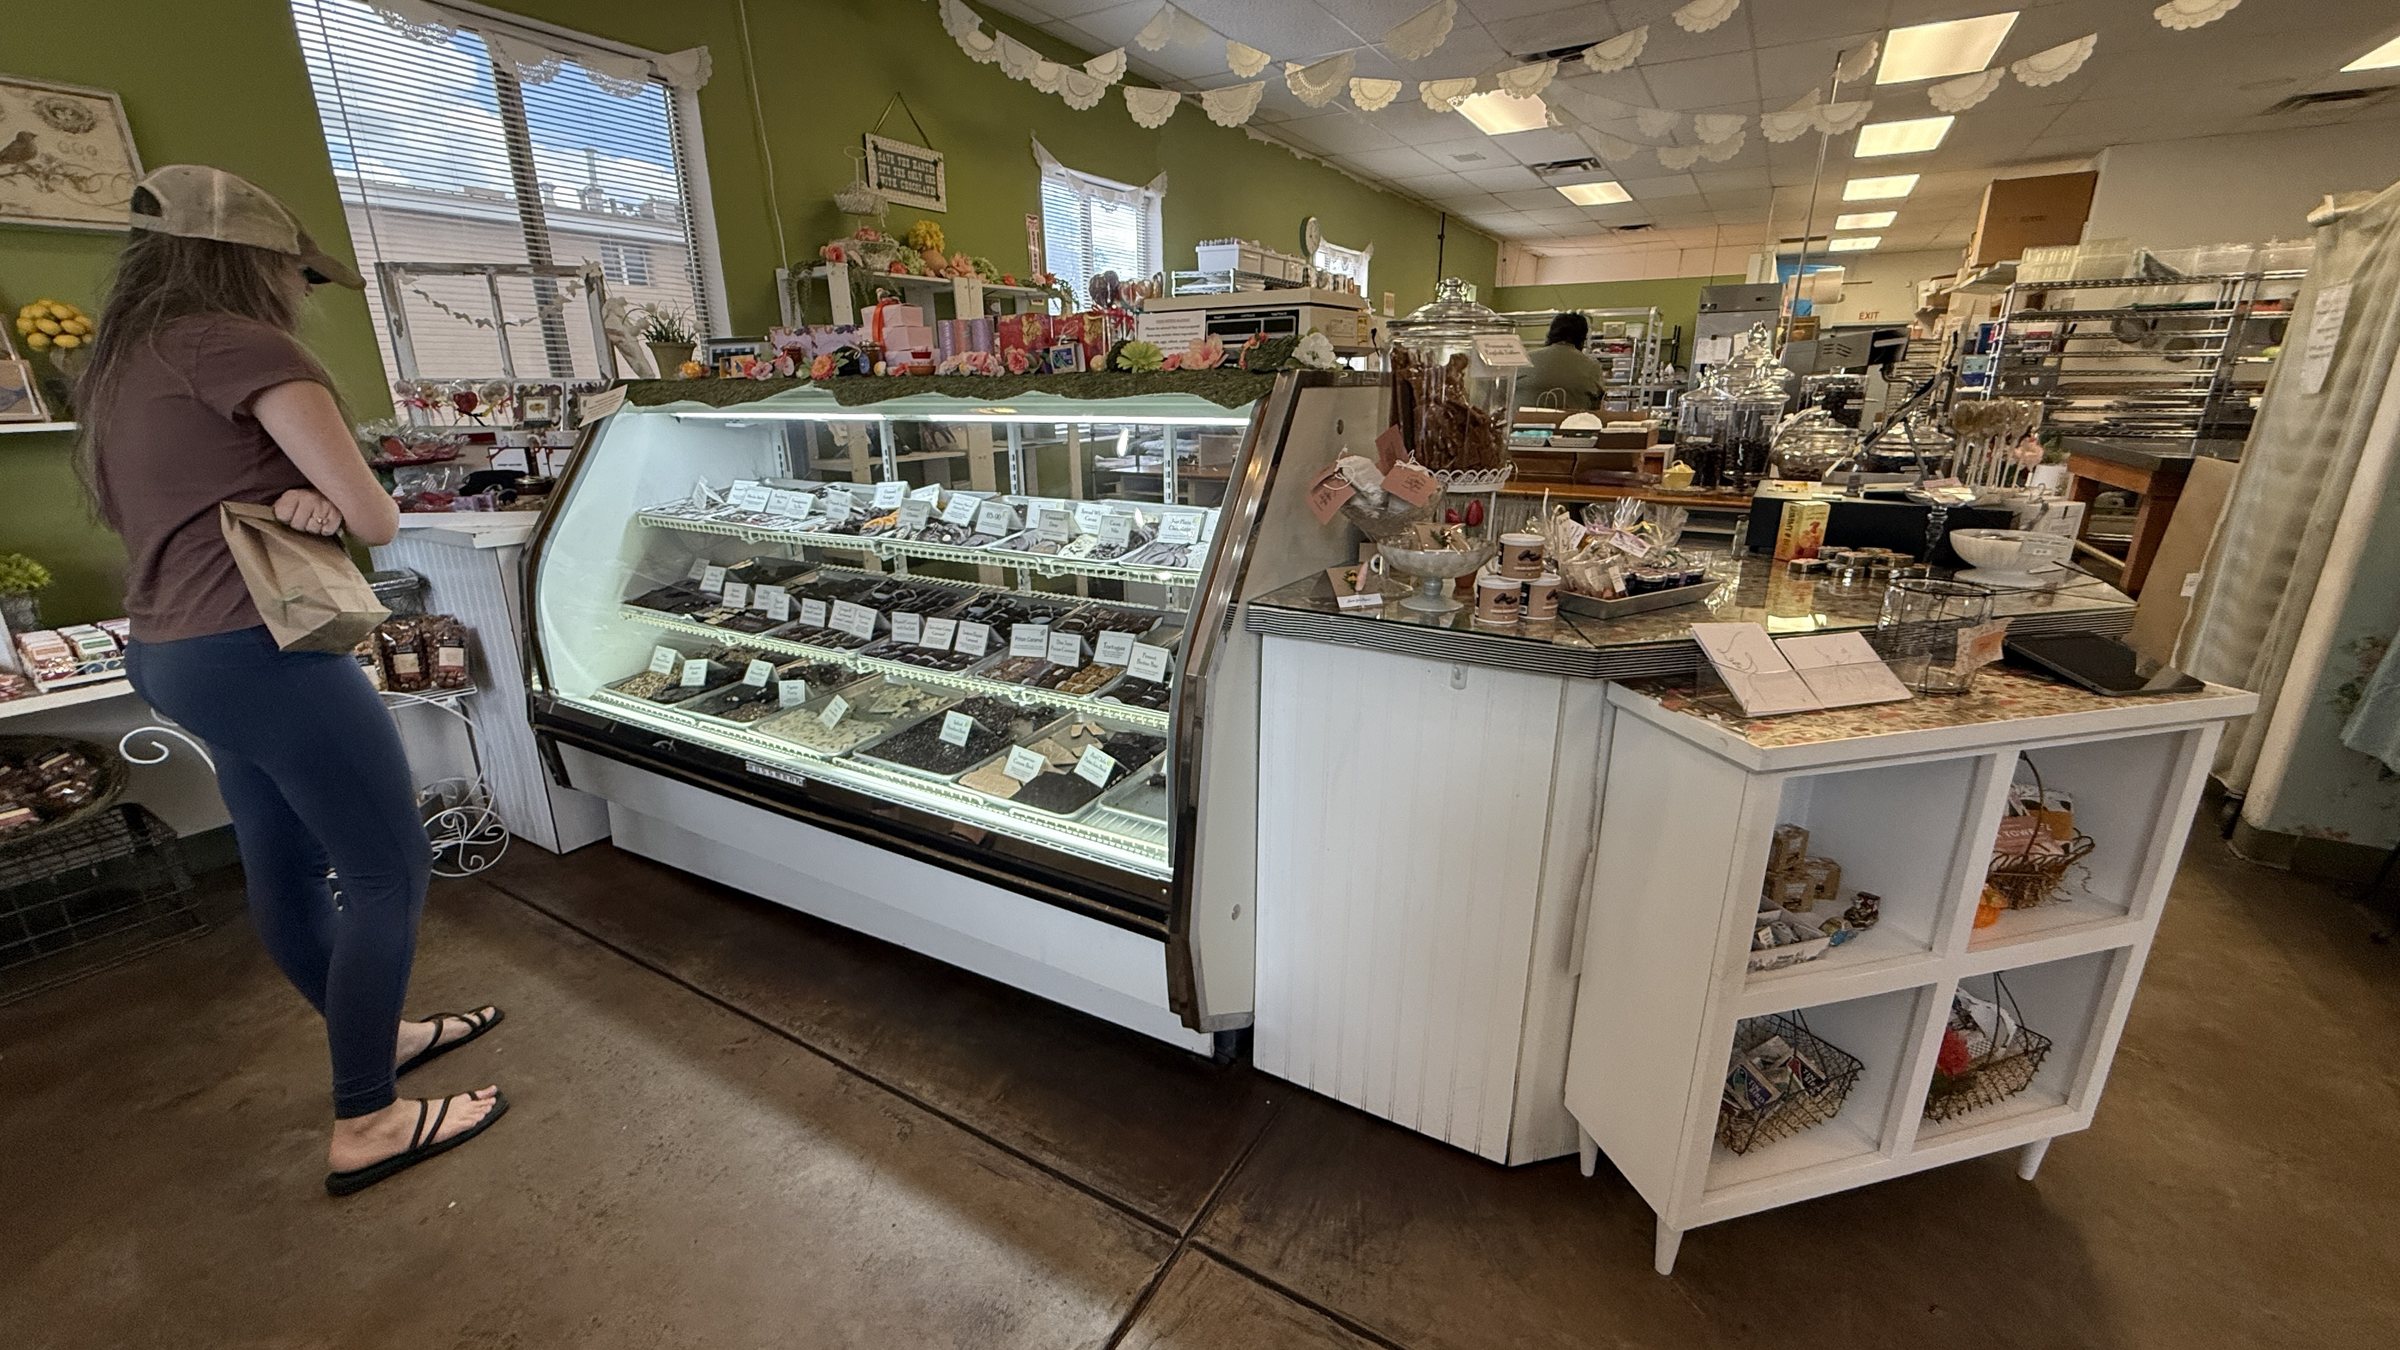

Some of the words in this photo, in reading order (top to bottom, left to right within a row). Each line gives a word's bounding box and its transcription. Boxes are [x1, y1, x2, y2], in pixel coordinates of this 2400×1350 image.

[897, 156, 910, 168] THE
[893, 167, 906, 178] THE
[1858, 311, 1880, 320] EXIT
